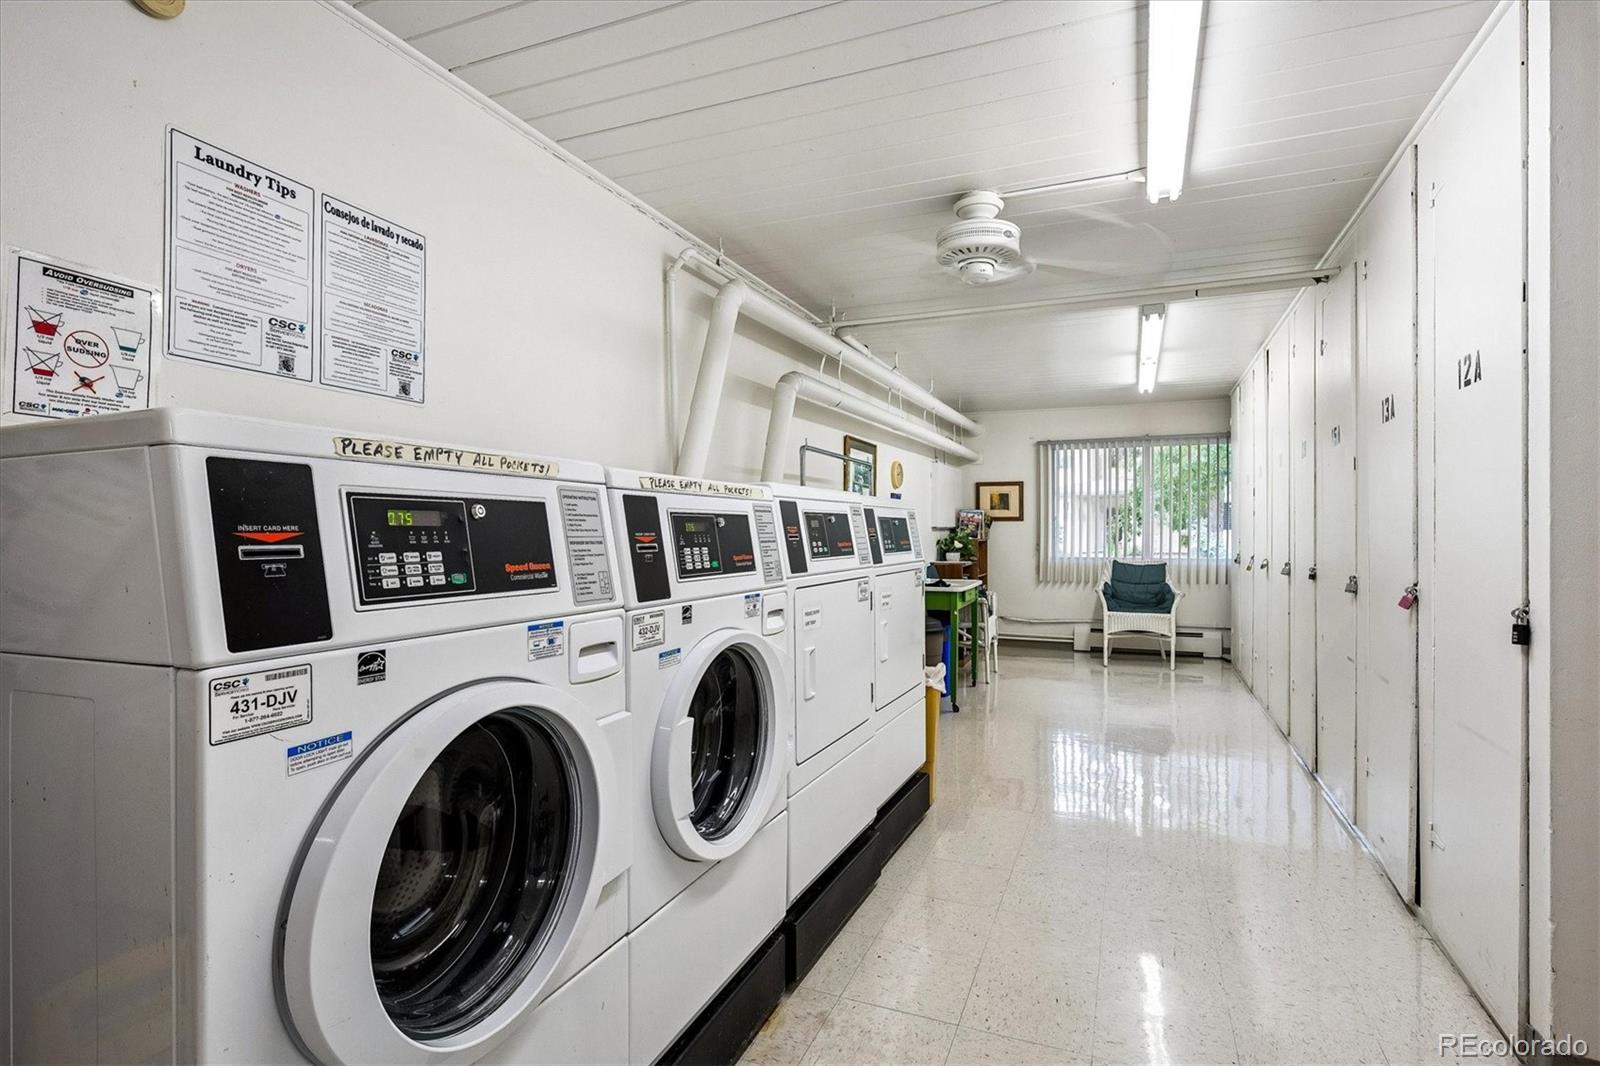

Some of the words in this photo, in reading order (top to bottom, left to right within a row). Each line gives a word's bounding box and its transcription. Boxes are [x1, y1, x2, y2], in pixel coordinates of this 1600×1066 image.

[194, 146, 262, 187] Laundry
[266, 176, 296, 199] Tips
[324, 201, 359, 224] Consejos
[361, 216, 370, 229] de
[371, 220, 394, 239] lavado
[394, 234, 400, 244] y
[401, 236, 424, 251] secado
[45, 268, 74, 281] AVOID
[76, 277, 132, 297] OVERSUDSING
[269, 318, 296, 330] CSC
[75, 339, 99, 348] OVER
[67, 345, 106, 359] SUDSING
[391, 349, 412, 360] CSC
[1458, 350, 1482, 390] 12A
[1382, 393, 1395, 424] 13A
[340, 438, 404, 459] PLEASE
[414, 447, 463, 465] EMPTY
[472, 454, 494, 467] ALL
[649, 477, 675, 489] PLEASE
[680, 480, 703, 490] EMPTY
[708, 484, 719, 492] ALL
[505, 563, 528, 572] Speed
[638, 625, 660, 636] 432-DJV
[214, 680, 240, 691] CSC
[230, 689, 297, 714] 431-DJV
[297, 736, 344, 753] NOTICE
